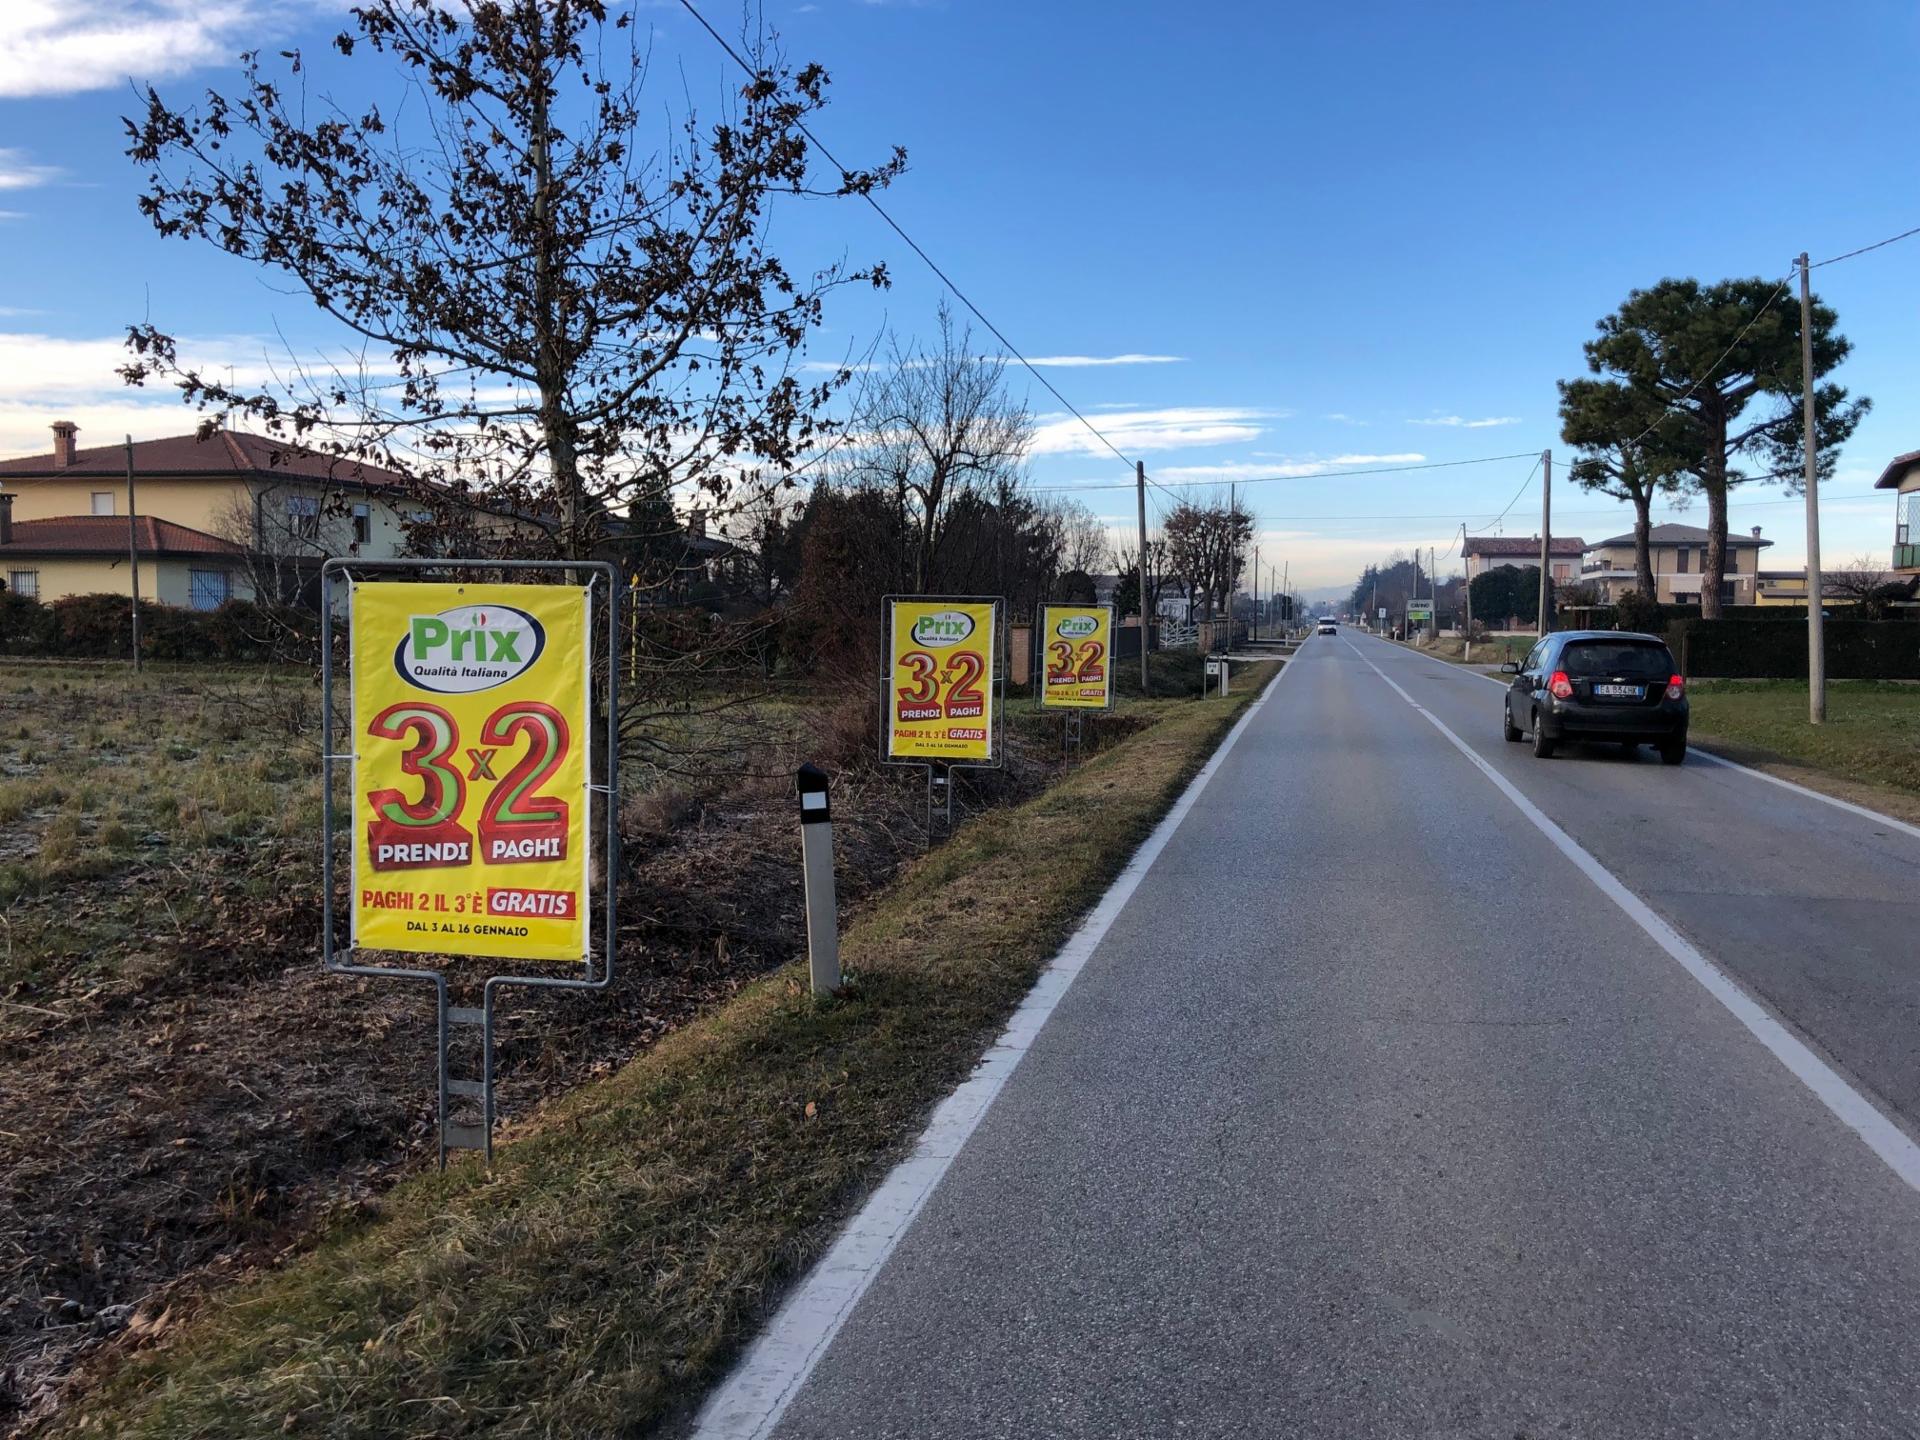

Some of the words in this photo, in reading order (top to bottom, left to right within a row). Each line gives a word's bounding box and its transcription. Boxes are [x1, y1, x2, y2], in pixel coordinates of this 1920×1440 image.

[919, 614, 965, 636] Prix
[1062, 618, 1092, 631] Prix
[412, 612, 522, 662] Prix
[414, 666, 457, 677] Qualità
[462, 667, 508, 678] Italiana
[902, 710, 940, 718] PRENDI
[950, 707, 980, 716] PAGHI
[894, 730, 916, 738] PAGHI
[918, 730, 924, 738] 2
[950, 730, 984, 739] GRATIS
[378, 842, 469, 863] PRENDI
[492, 838, 560, 859] PAGHI
[362, 890, 413, 910] PAGHI
[418, 893, 429, 911] 2
[434, 894, 450, 912] IL
[492, 892, 568, 915] GRATIS
[406, 921, 428, 932] DAL
[432, 922, 438, 932] 3
[441, 923, 454, 933] AL
[458, 924, 470, 934] 16
[474, 924, 528, 937] GENNAIO
